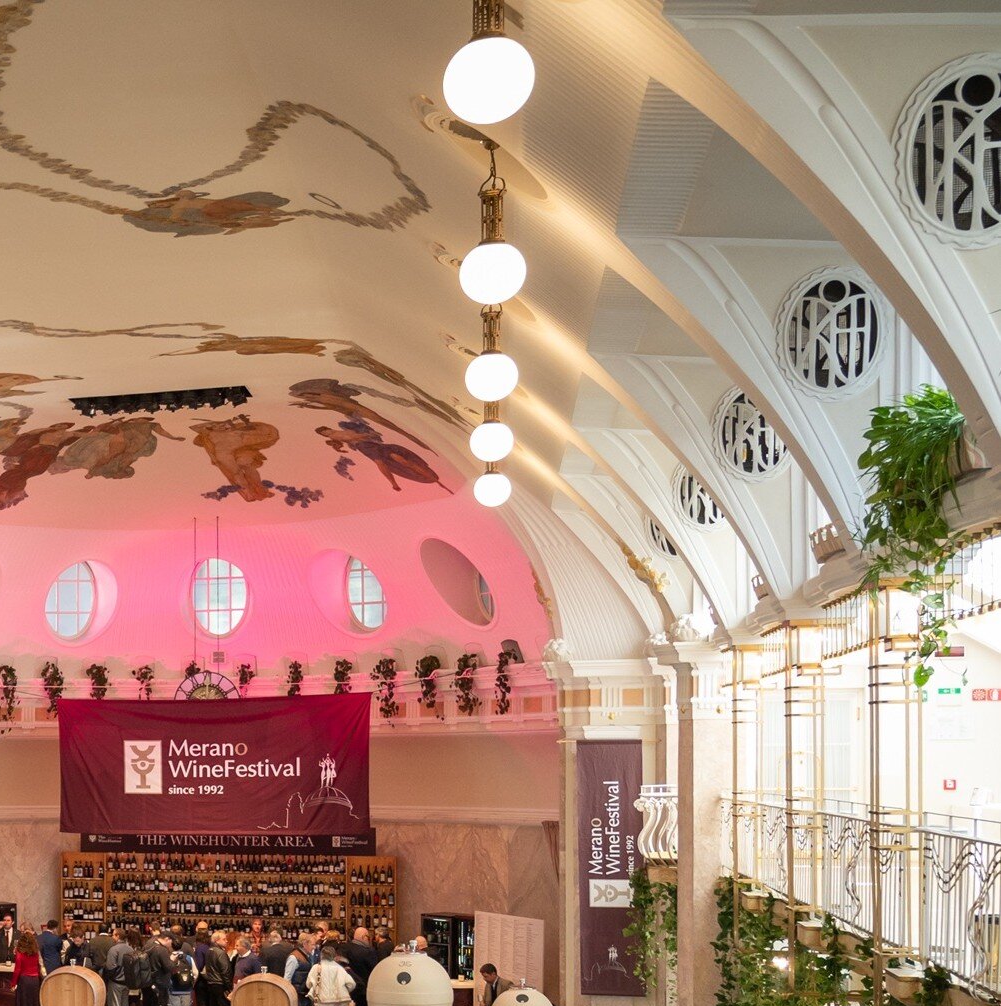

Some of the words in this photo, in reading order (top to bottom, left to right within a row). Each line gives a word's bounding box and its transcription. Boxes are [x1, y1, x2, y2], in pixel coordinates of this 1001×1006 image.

[168, 739, 248, 757] Merano
[168, 757, 301, 778] WineFestival
[168, 784, 195, 795] since
[198, 785, 224, 795] 1992
[603, 781, 621, 876] WineFestival
[137, 834, 167, 846] THE
[170, 835, 270, 847] WINEHUNTER
[274, 836, 315, 847] AREA
[588, 818, 603, 875] Merano
[626, 835, 634, 853] 1992
[626, 856, 635, 876] since
